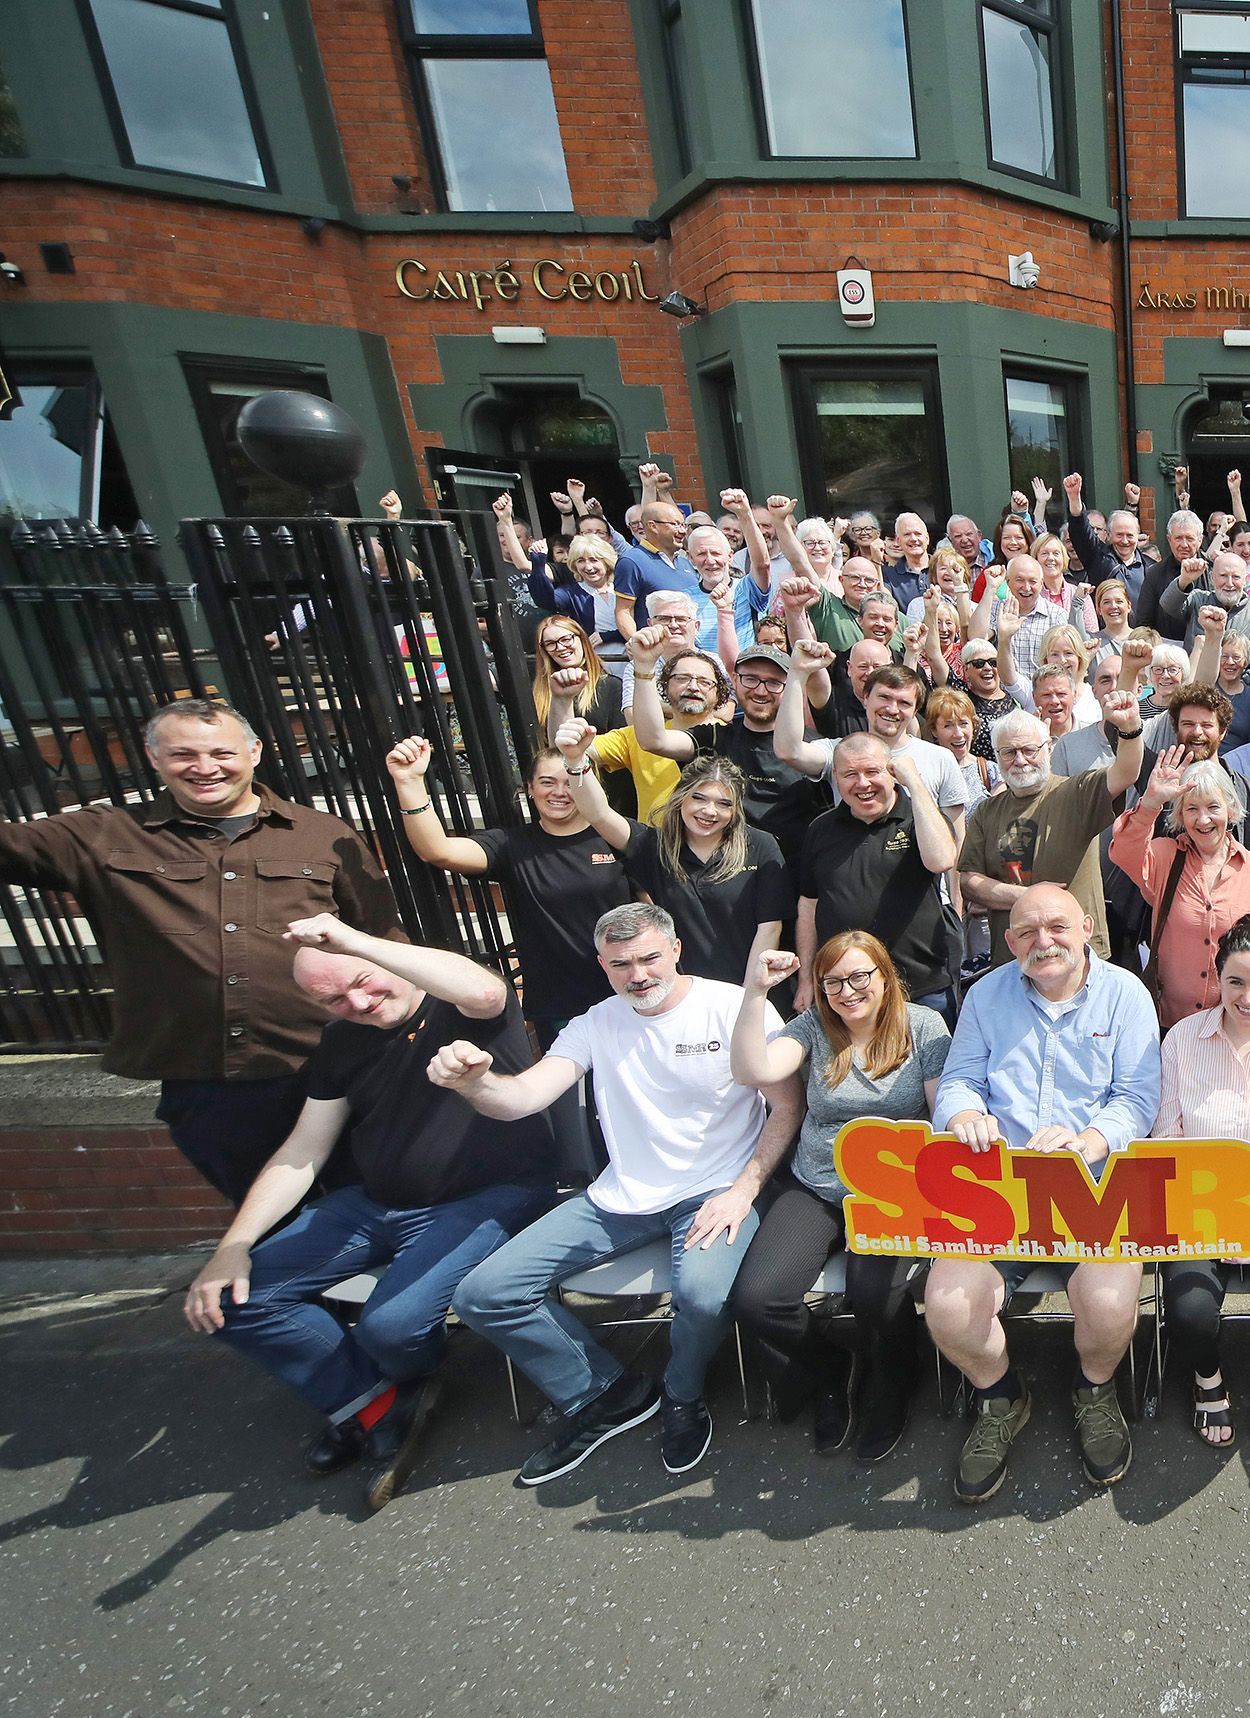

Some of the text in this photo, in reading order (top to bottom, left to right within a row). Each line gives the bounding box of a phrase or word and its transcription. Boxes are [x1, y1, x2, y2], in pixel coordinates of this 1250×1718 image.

[531, 258, 659, 302] Ceoil
[675, 1042, 707, 1054] SSMR
[855, 1233, 1243, 1258] Scoil Samhraidh Mhic Reachtain
